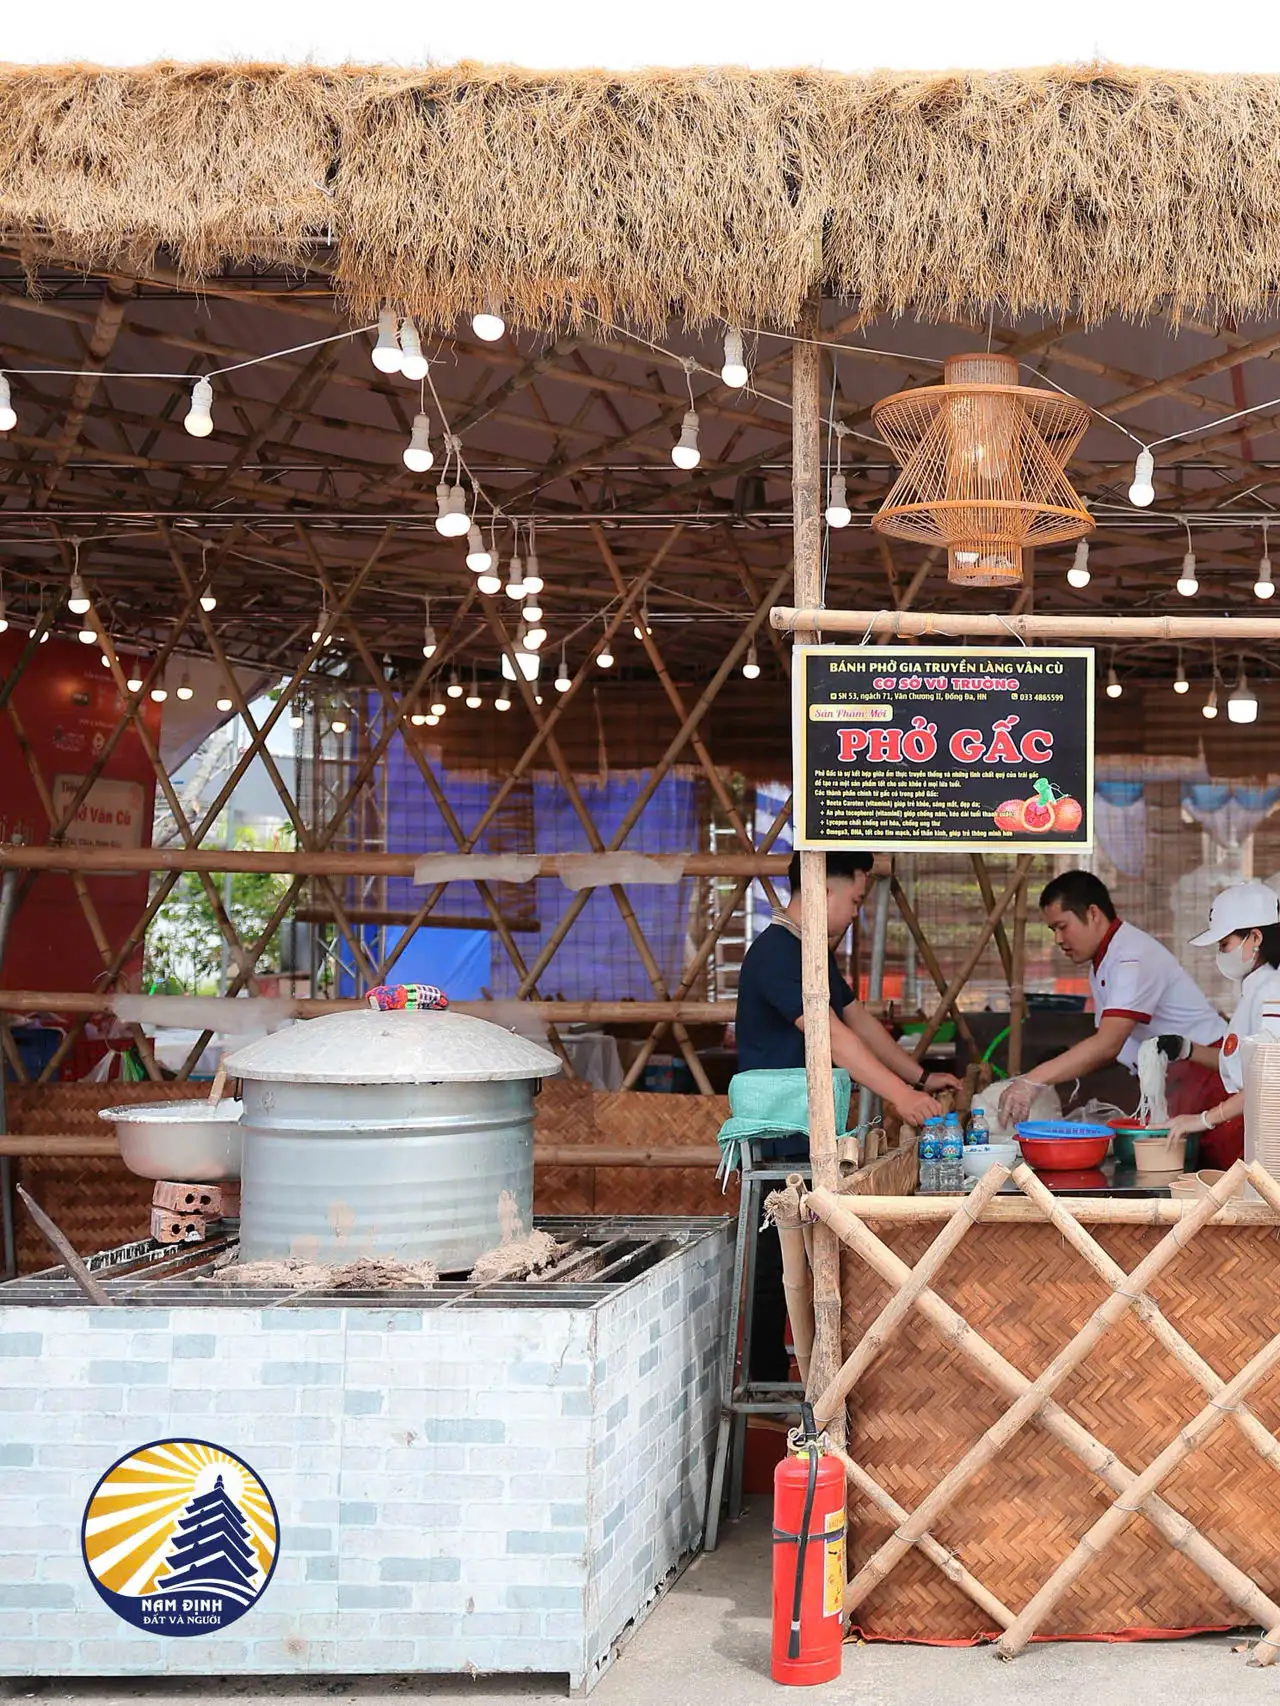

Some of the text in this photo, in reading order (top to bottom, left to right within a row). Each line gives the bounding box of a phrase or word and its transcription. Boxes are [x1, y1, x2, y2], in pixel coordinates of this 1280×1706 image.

[829, 659, 1063, 674] BÁNH PHỞ GIA TRUYỀN LÀNG VÂN CÙ
[873, 677, 896, 690] CƠ
[899, 675, 922, 690] SỞ
[838, 715, 1053, 762] PHỞ GẤC
